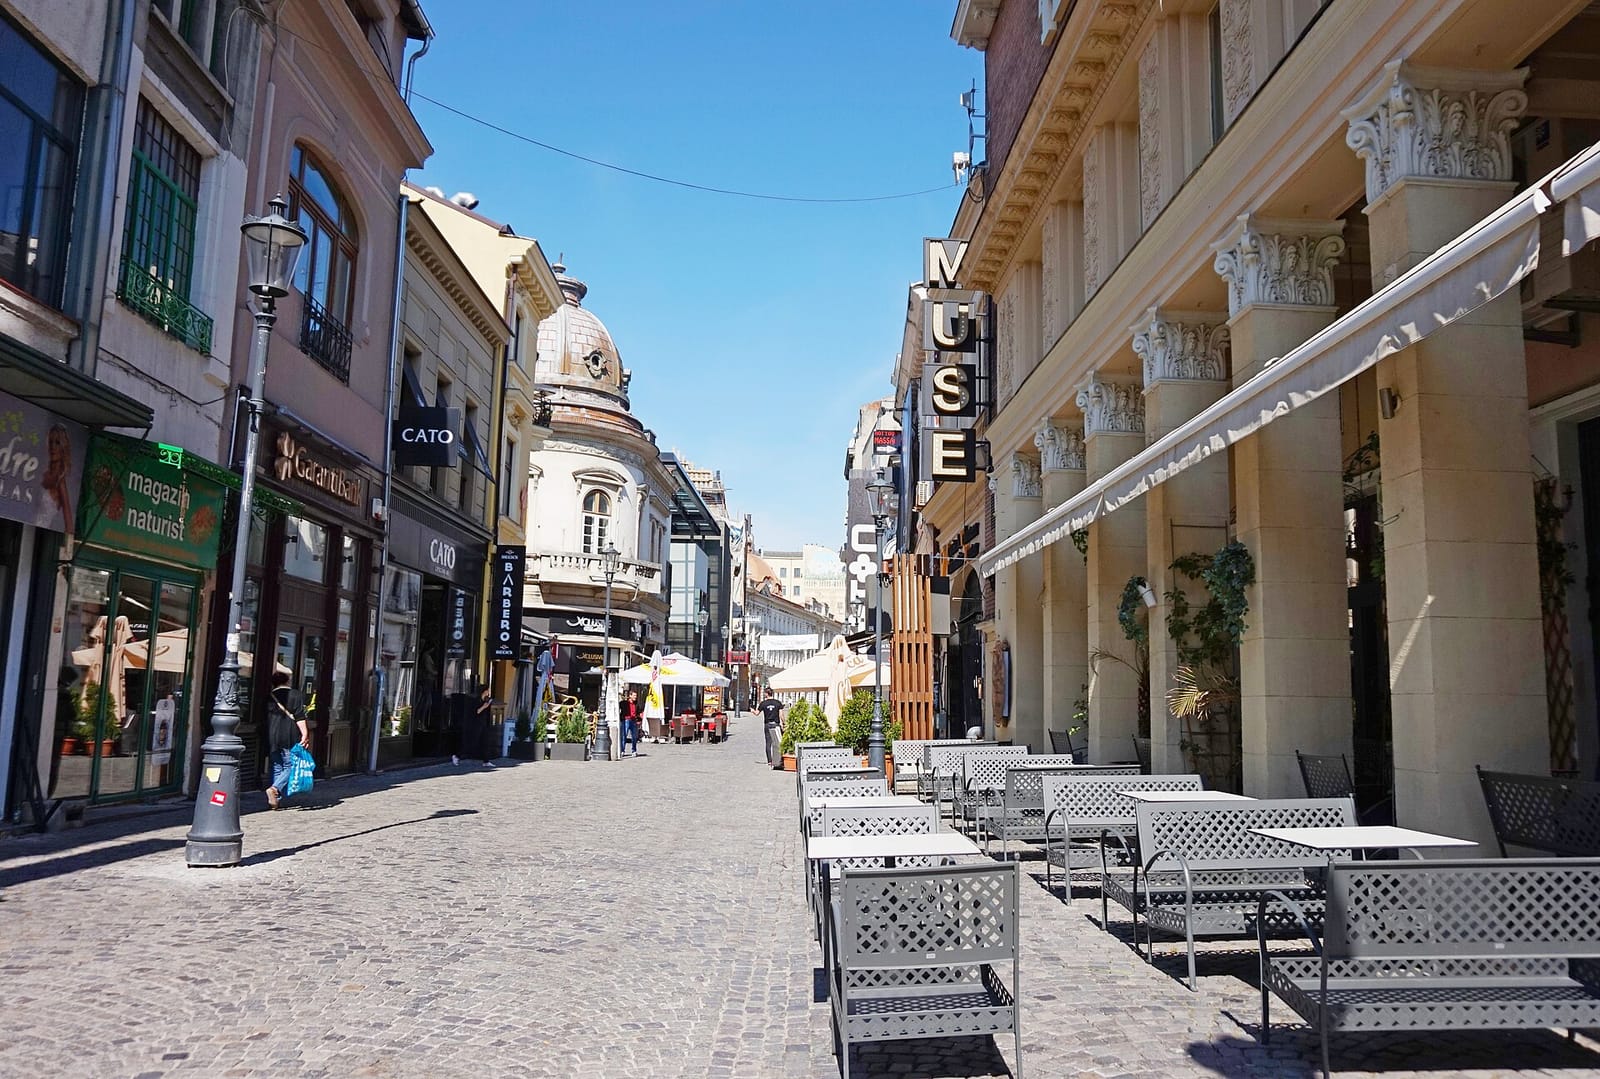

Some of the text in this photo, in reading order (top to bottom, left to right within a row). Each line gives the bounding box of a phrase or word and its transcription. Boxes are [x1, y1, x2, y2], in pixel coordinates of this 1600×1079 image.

[929, 240, 970, 477] MUSE
[401, 427, 454, 444] CATO
[128, 471, 191, 510] magazin
[295, 447, 362, 507] GarantiBank
[127, 508, 185, 541] naturist
[430, 539, 456, 569] CATO
[500, 562, 514, 642] BARBERO
